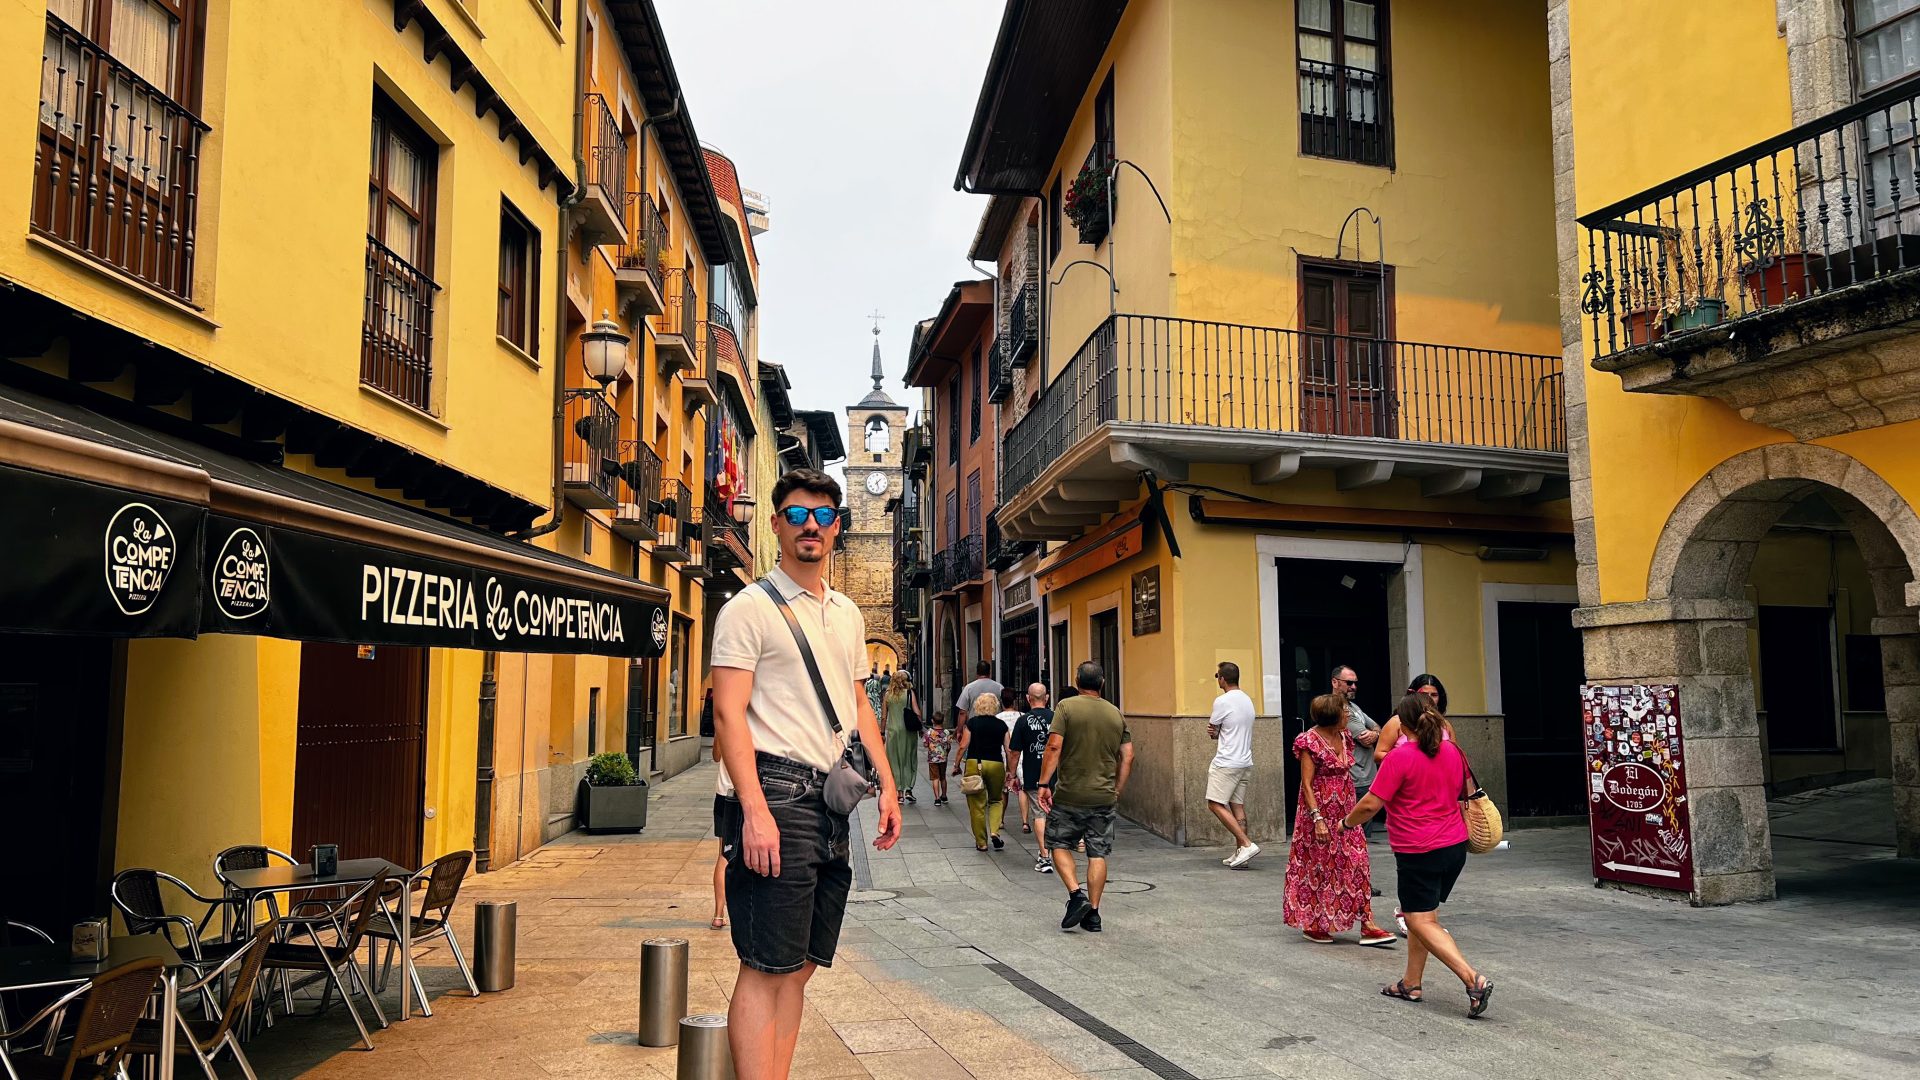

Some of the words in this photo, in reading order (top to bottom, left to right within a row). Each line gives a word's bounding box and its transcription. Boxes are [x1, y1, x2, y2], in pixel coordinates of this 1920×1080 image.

[133, 517, 152, 544] La
[112, 535, 171, 569] COMPE
[241, 539, 255, 560] La
[112, 564, 163, 592] TENCIA
[222, 554, 265, 582] COMPE
[219, 578, 269, 601] TENCIA
[230, 600, 255, 608] PIZZERIA
[361, 564, 479, 630] PIZZERIA
[486, 576, 513, 641] La
[513, 590, 625, 643] COMPETENCIA
[1624, 765, 1639, 784] El
[1607, 779, 1659, 800] Bodegón
[1626, 800, 1643, 809] 1705
